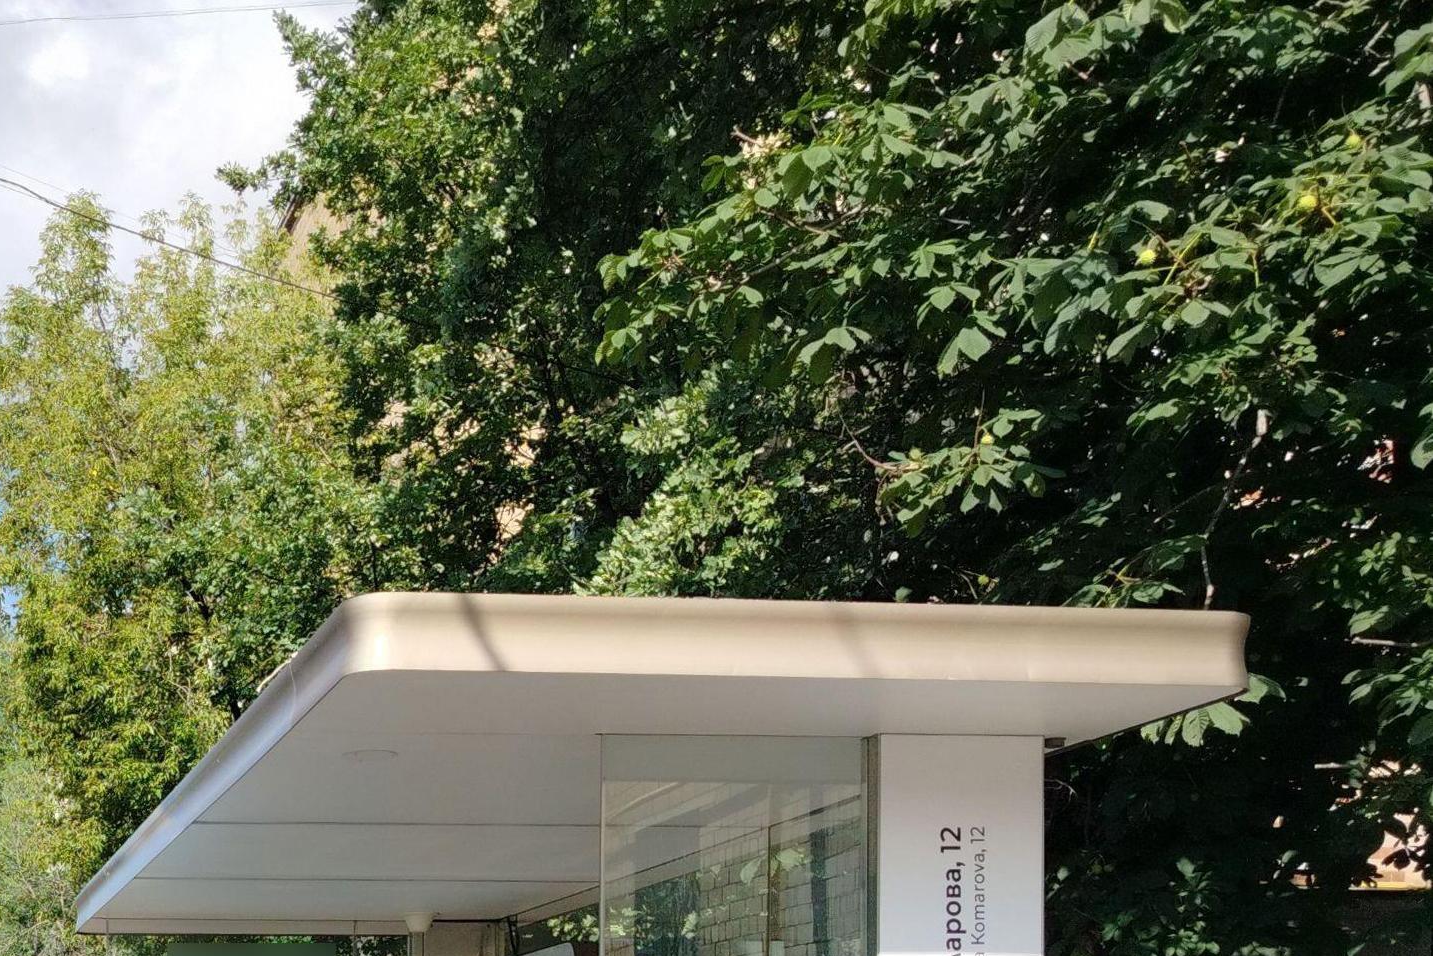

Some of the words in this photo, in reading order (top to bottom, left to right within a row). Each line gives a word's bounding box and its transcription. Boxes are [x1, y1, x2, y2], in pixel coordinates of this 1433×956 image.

[940, 826, 962, 854] 12
[970, 825, 986, 845] 12
[970, 848, 987, 945] Komarova,
